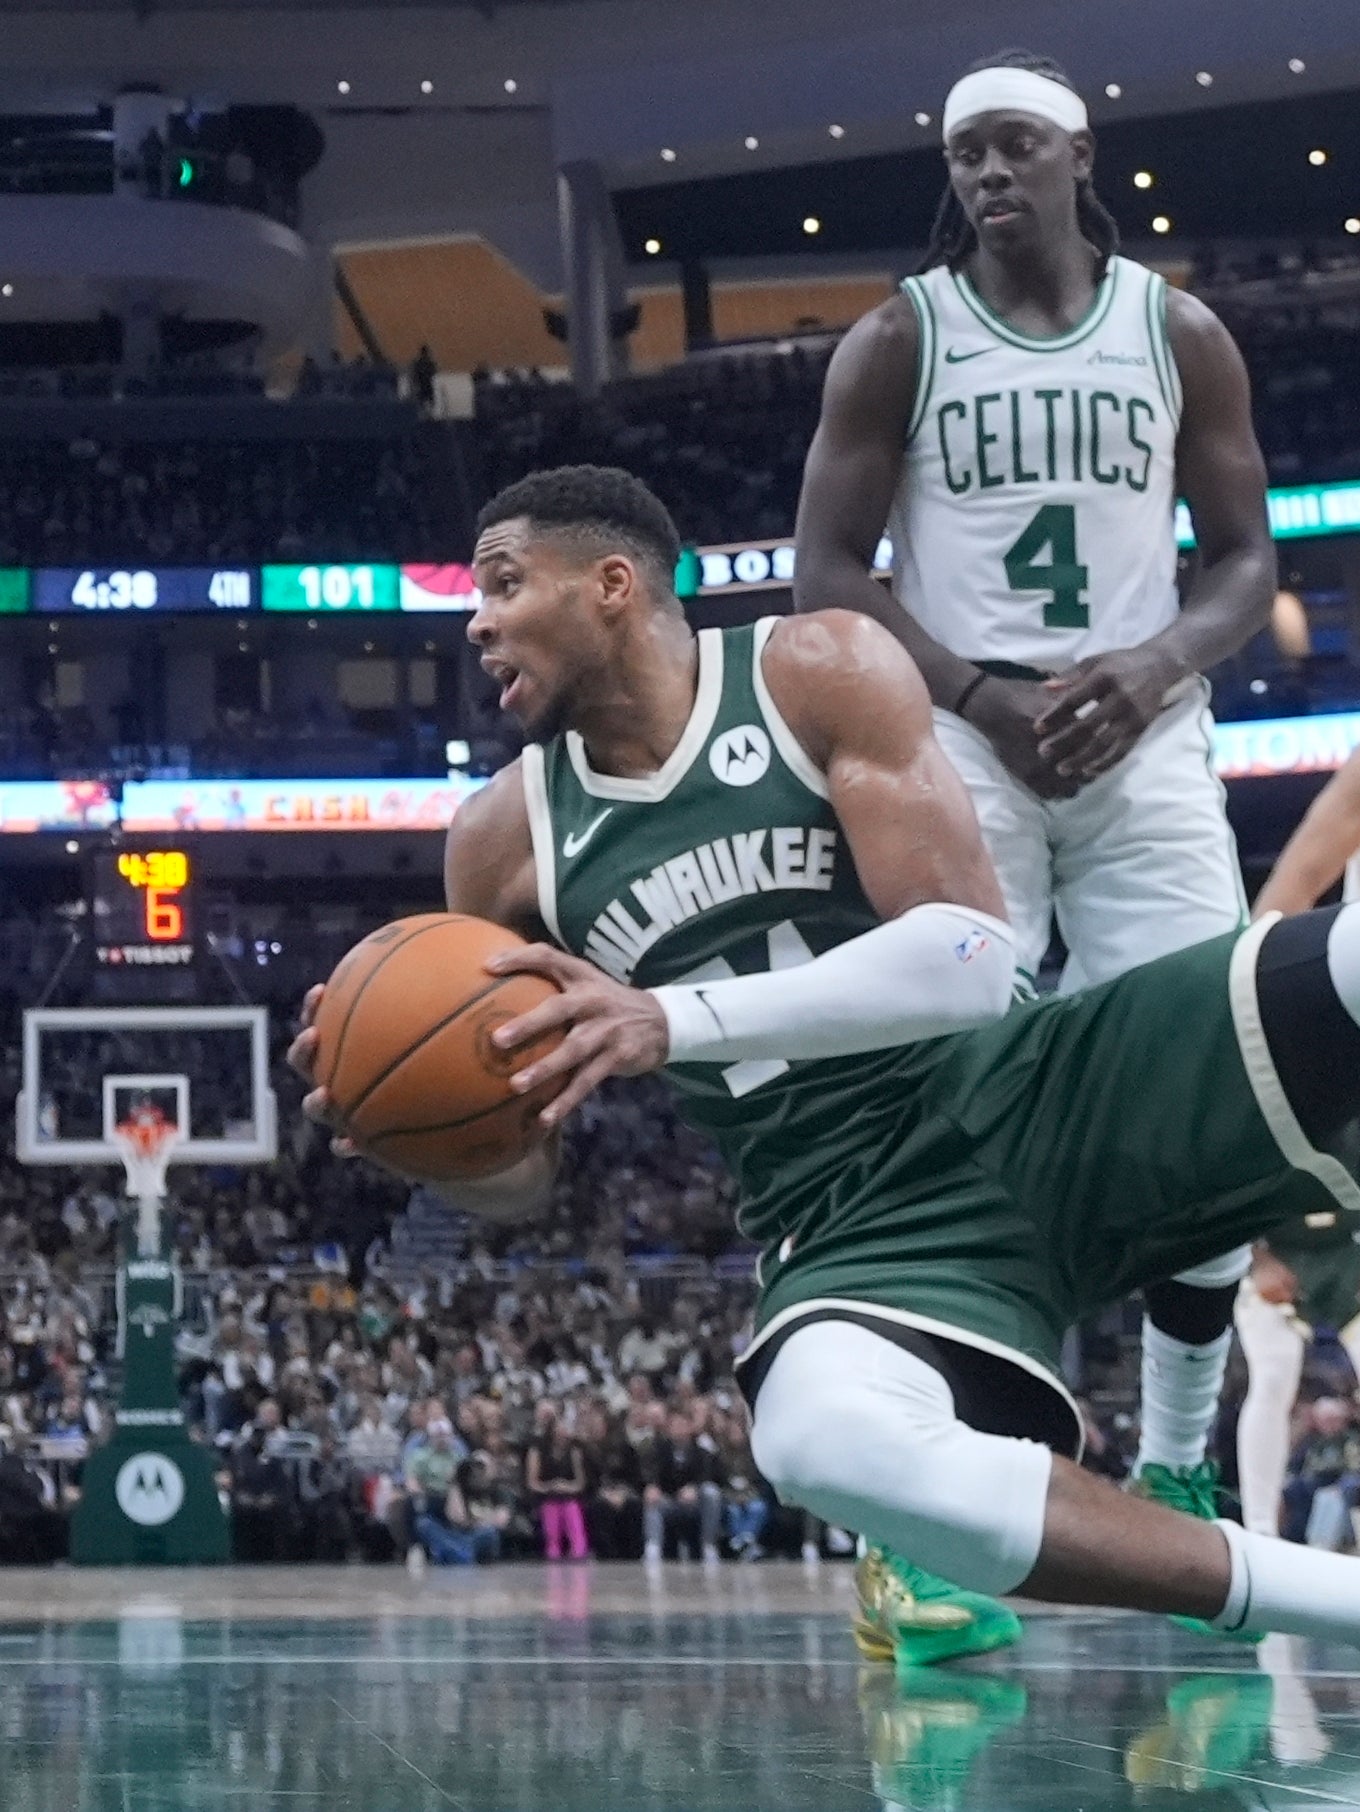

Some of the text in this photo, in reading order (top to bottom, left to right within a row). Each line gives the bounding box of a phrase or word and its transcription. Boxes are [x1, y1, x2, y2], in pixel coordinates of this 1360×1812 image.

[938, 389, 1155, 494] CELTICS
[208, 570, 250, 608] 4TH
[299, 565, 375, 609] 101
[1003, 504, 1090, 628] 4
[263, 793, 370, 822] CASH
[146, 886, 182, 940] 6
[584, 827, 837, 985] MILWAUKEE
